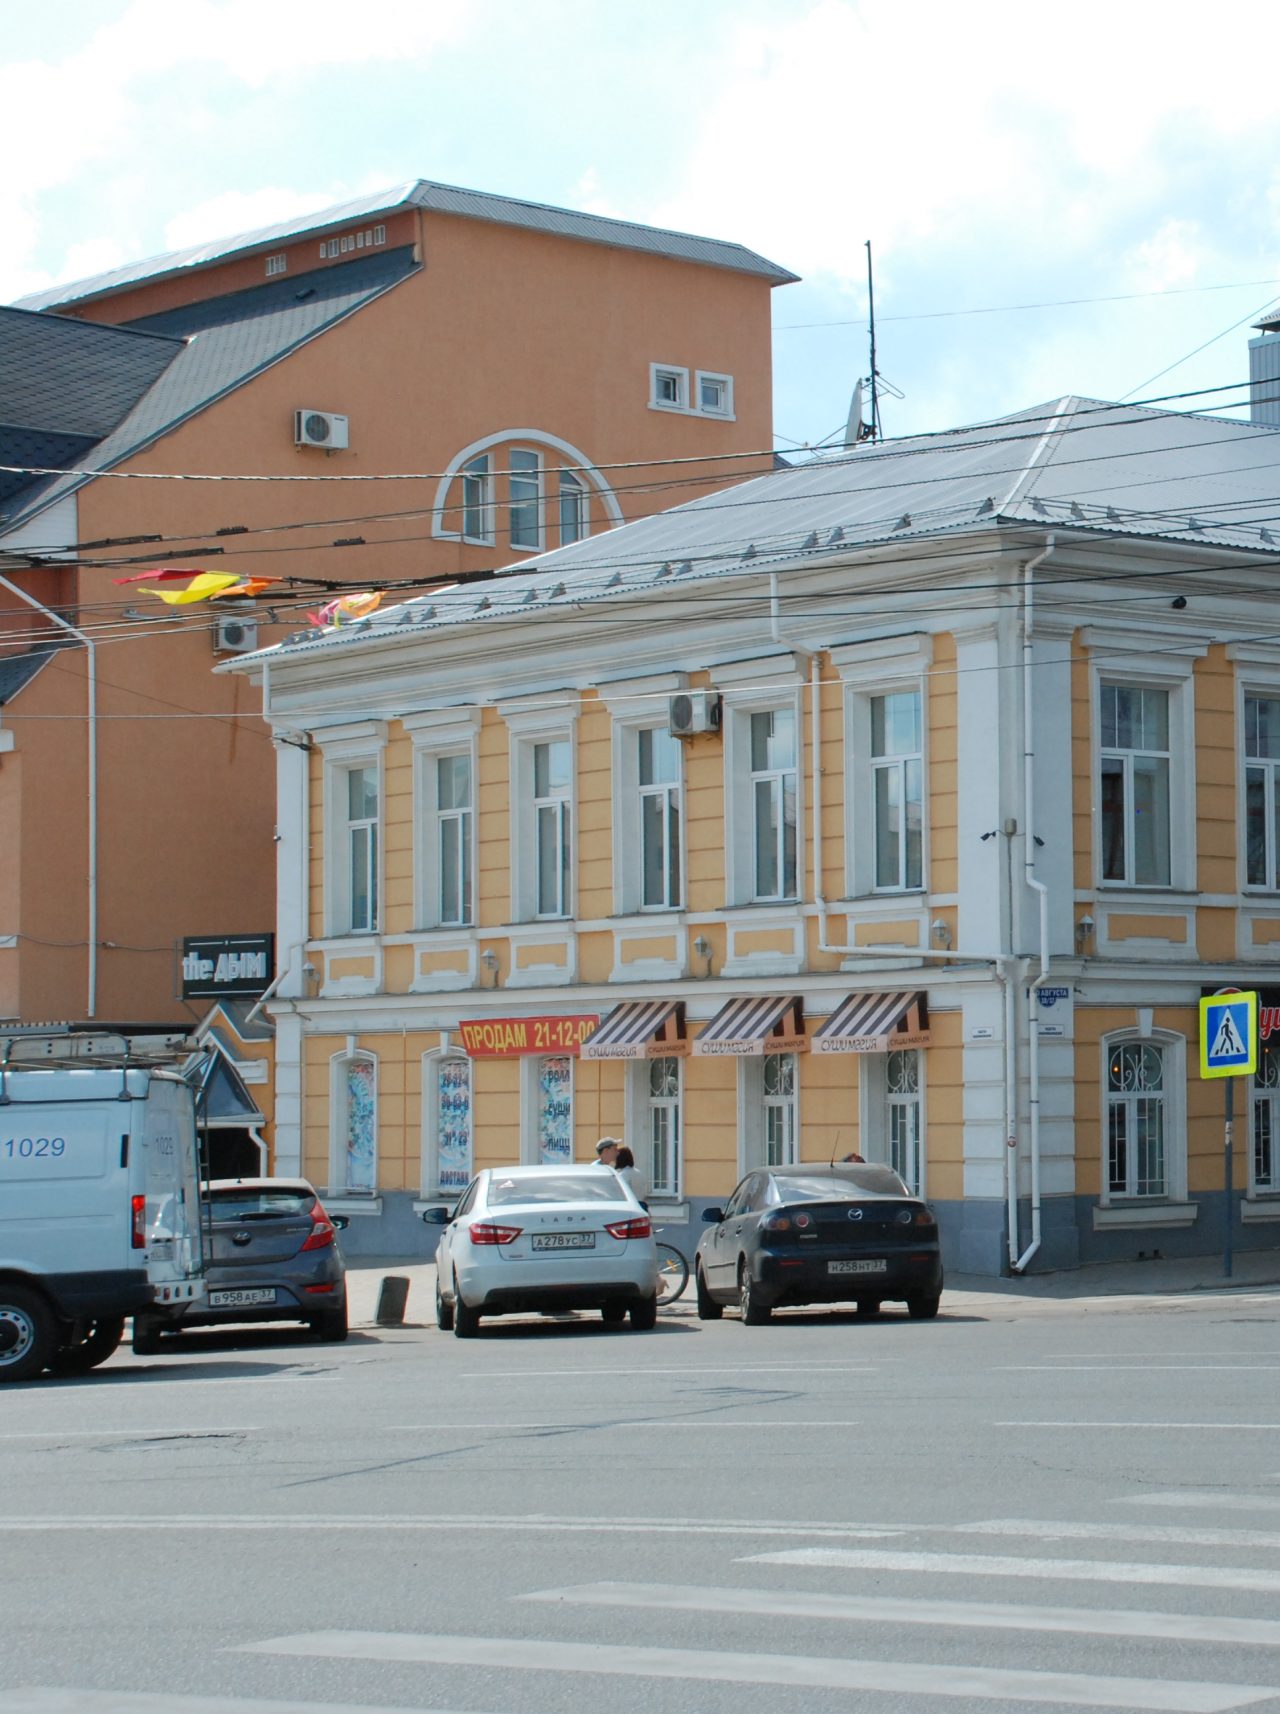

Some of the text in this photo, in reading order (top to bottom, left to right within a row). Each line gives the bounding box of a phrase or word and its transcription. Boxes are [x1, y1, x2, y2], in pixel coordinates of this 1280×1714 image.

[182, 951, 214, 981] the
[1040, 989, 1068, 997] АВГУСТА
[462, 1022, 527, 1053] ПРОДАМ
[5, 1136, 66, 1158] 1029
